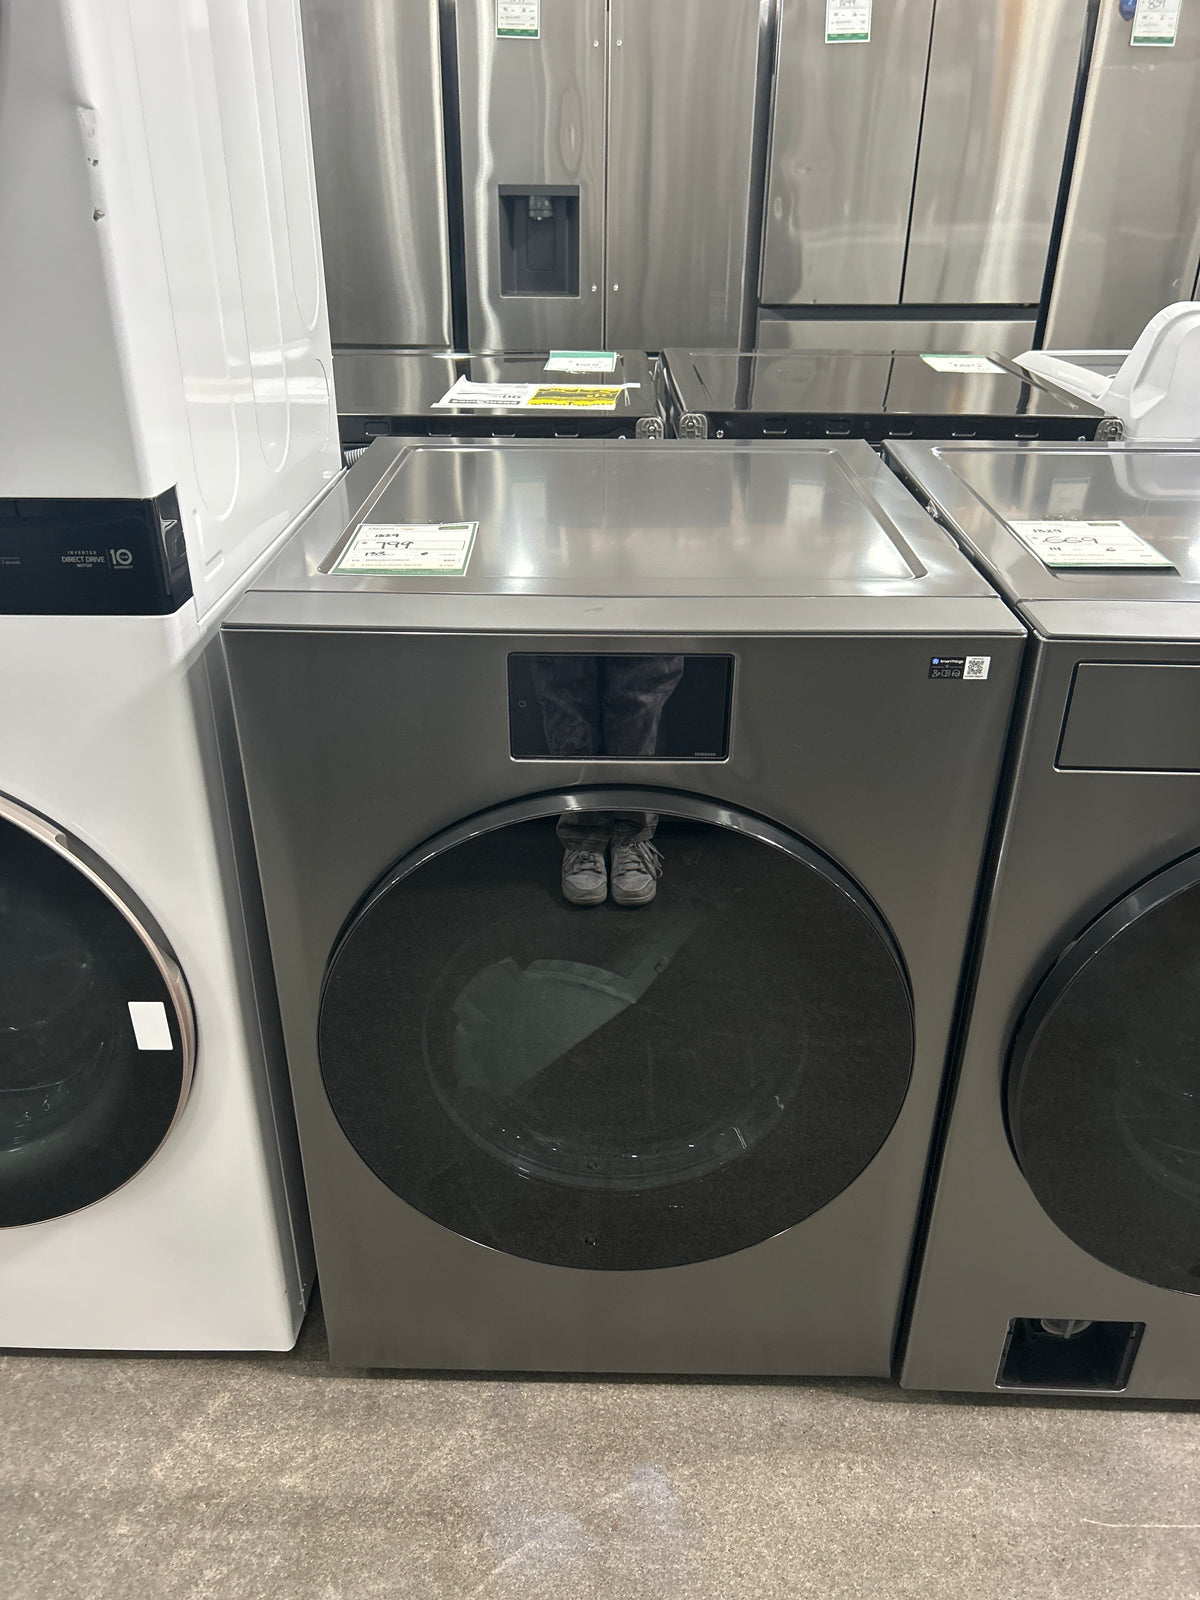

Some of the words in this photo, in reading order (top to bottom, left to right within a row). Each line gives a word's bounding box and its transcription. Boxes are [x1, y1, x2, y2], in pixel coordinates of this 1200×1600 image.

[375, 540, 414, 549] 799
[1042, 536, 1099, 545] 669
[110, 548, 133, 565] 10
